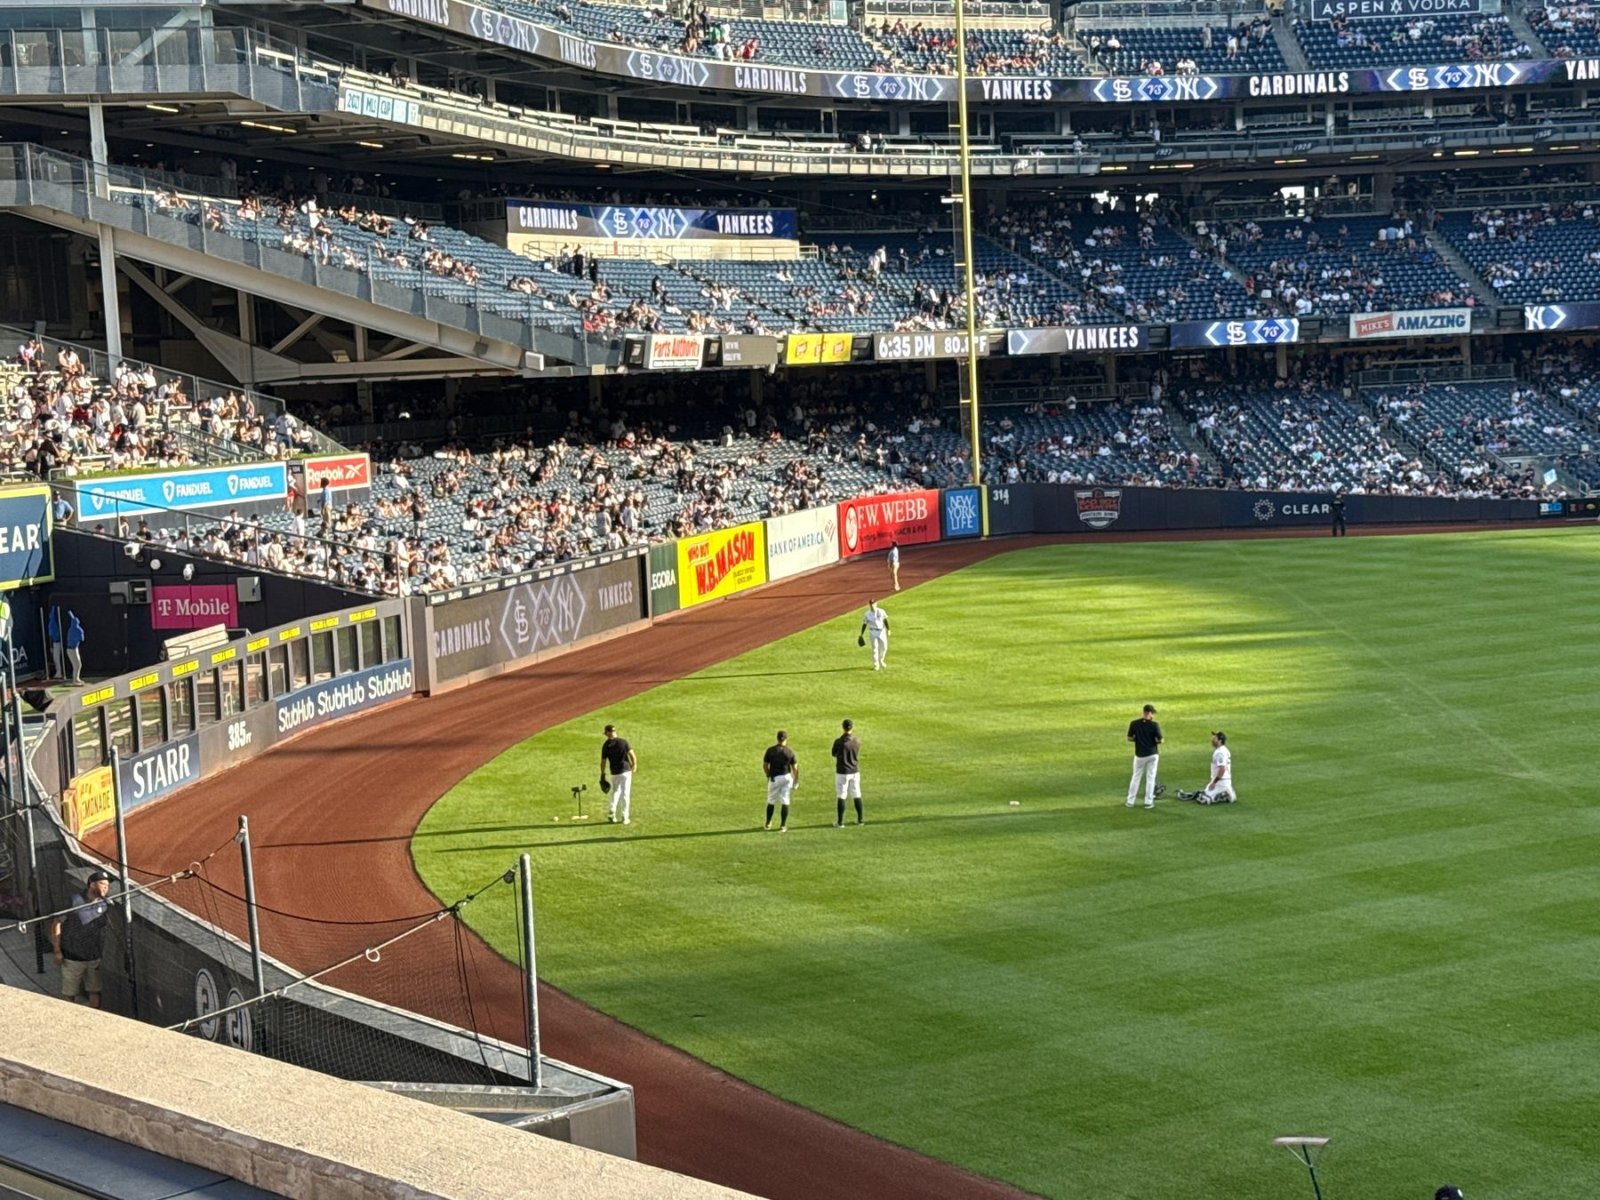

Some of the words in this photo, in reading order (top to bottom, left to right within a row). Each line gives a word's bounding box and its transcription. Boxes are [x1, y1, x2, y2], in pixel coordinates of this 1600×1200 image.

[1322, 1, 1381, 15] ASPEN
[558, 35, 597, 69] YANKEES
[734, 66, 807, 94] CARDINALS
[981, 79, 1052, 100] YANKEES
[1249, 72, 1349, 97] CARDINALS
[519, 206, 578, 230] CARDINALS
[716, 214, 774, 234] YANKEES
[1396, 314, 1466, 331] AMAZING
[879, 336, 911, 358] 6:35
[914, 335, 936, 356] PM
[1065, 326, 1139, 350] YANKEES
[307, 465, 344, 486] Reebok
[950, 495, 973, 508] NEW
[993, 489, 1009, 501] 314
[881, 498, 928, 524] WEBB
[947, 505, 976, 519] YORK
[1282, 503, 1330, 515] CLEAR
[952, 518, 974, 530] LIFE
[716, 530, 755, 579] MASON
[770, 540, 788, 557] BANK
[788, 537, 796, 552] OF
[797, 530, 825, 550] AMERICA
[175, 597, 230, 616] Mobile
[434, 617, 491, 658] CARDINALS
[598, 580, 633, 611] YANKEES
[278, 696, 315, 732] StubHub
[317, 681, 365, 716] StubHub
[368, 667, 412, 699] StubHub
[228, 720, 247, 751] 385
[133, 743, 191, 798] STARR
